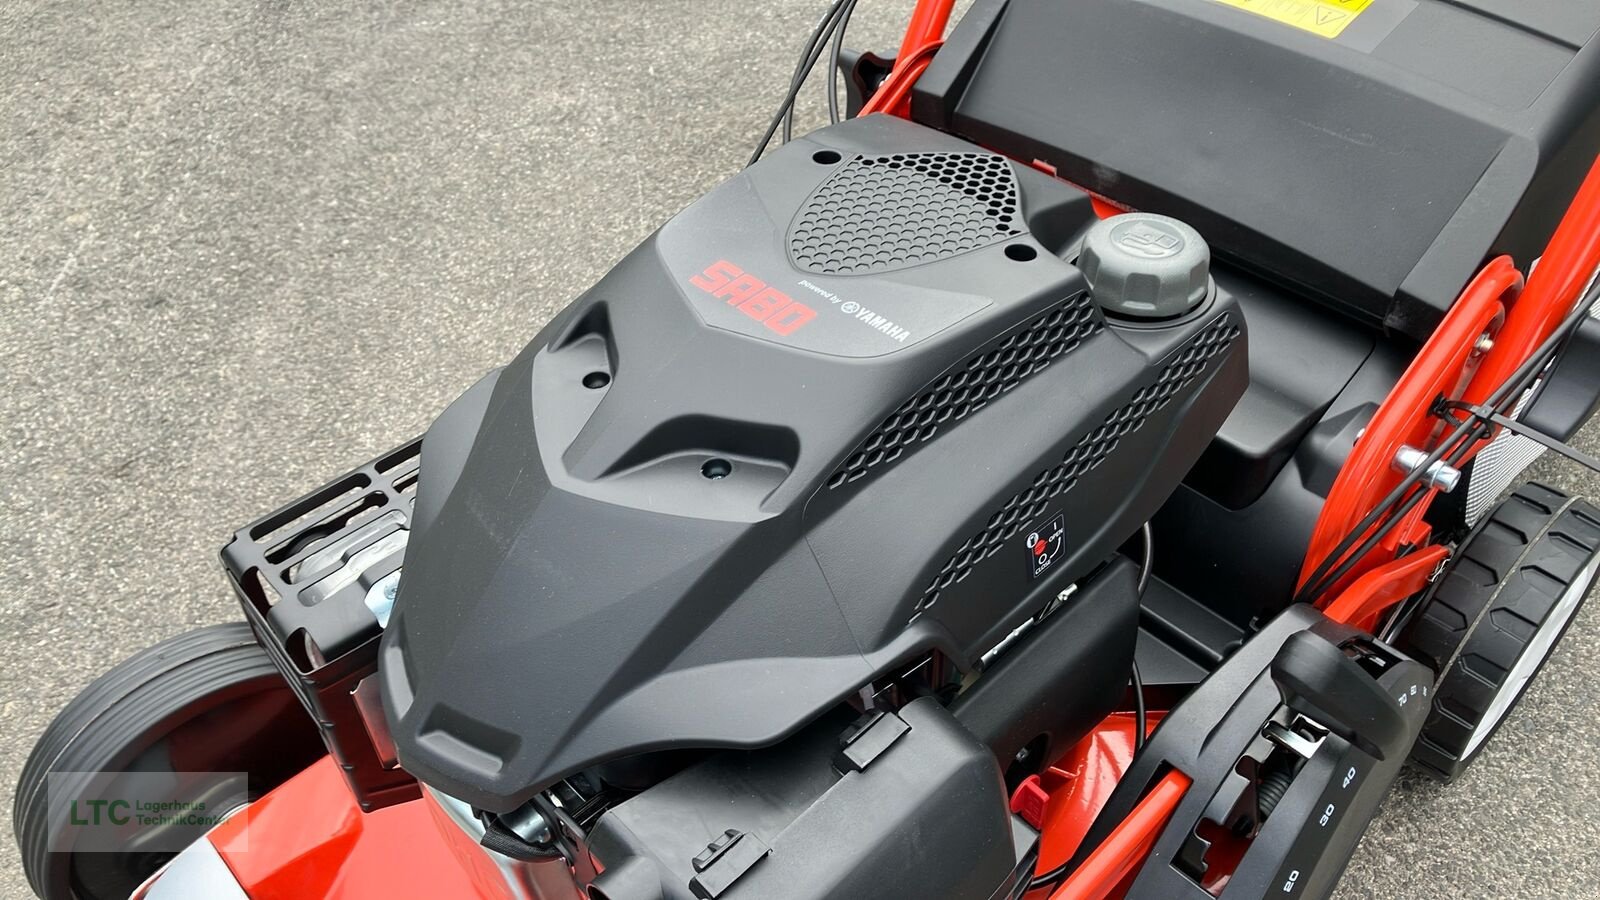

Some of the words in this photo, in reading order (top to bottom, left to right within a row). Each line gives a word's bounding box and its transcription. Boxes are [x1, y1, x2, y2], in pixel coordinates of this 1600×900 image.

[688, 259, 818, 337] SABO
[798, 279, 834, 298] powered
[855, 307, 911, 343] YAMAHA
[1035, 559, 1051, 575] CLOSE
[1342, 766, 1356, 789] 40
[1319, 803, 1335, 827] 30
[1283, 869, 1300, 893] 20
